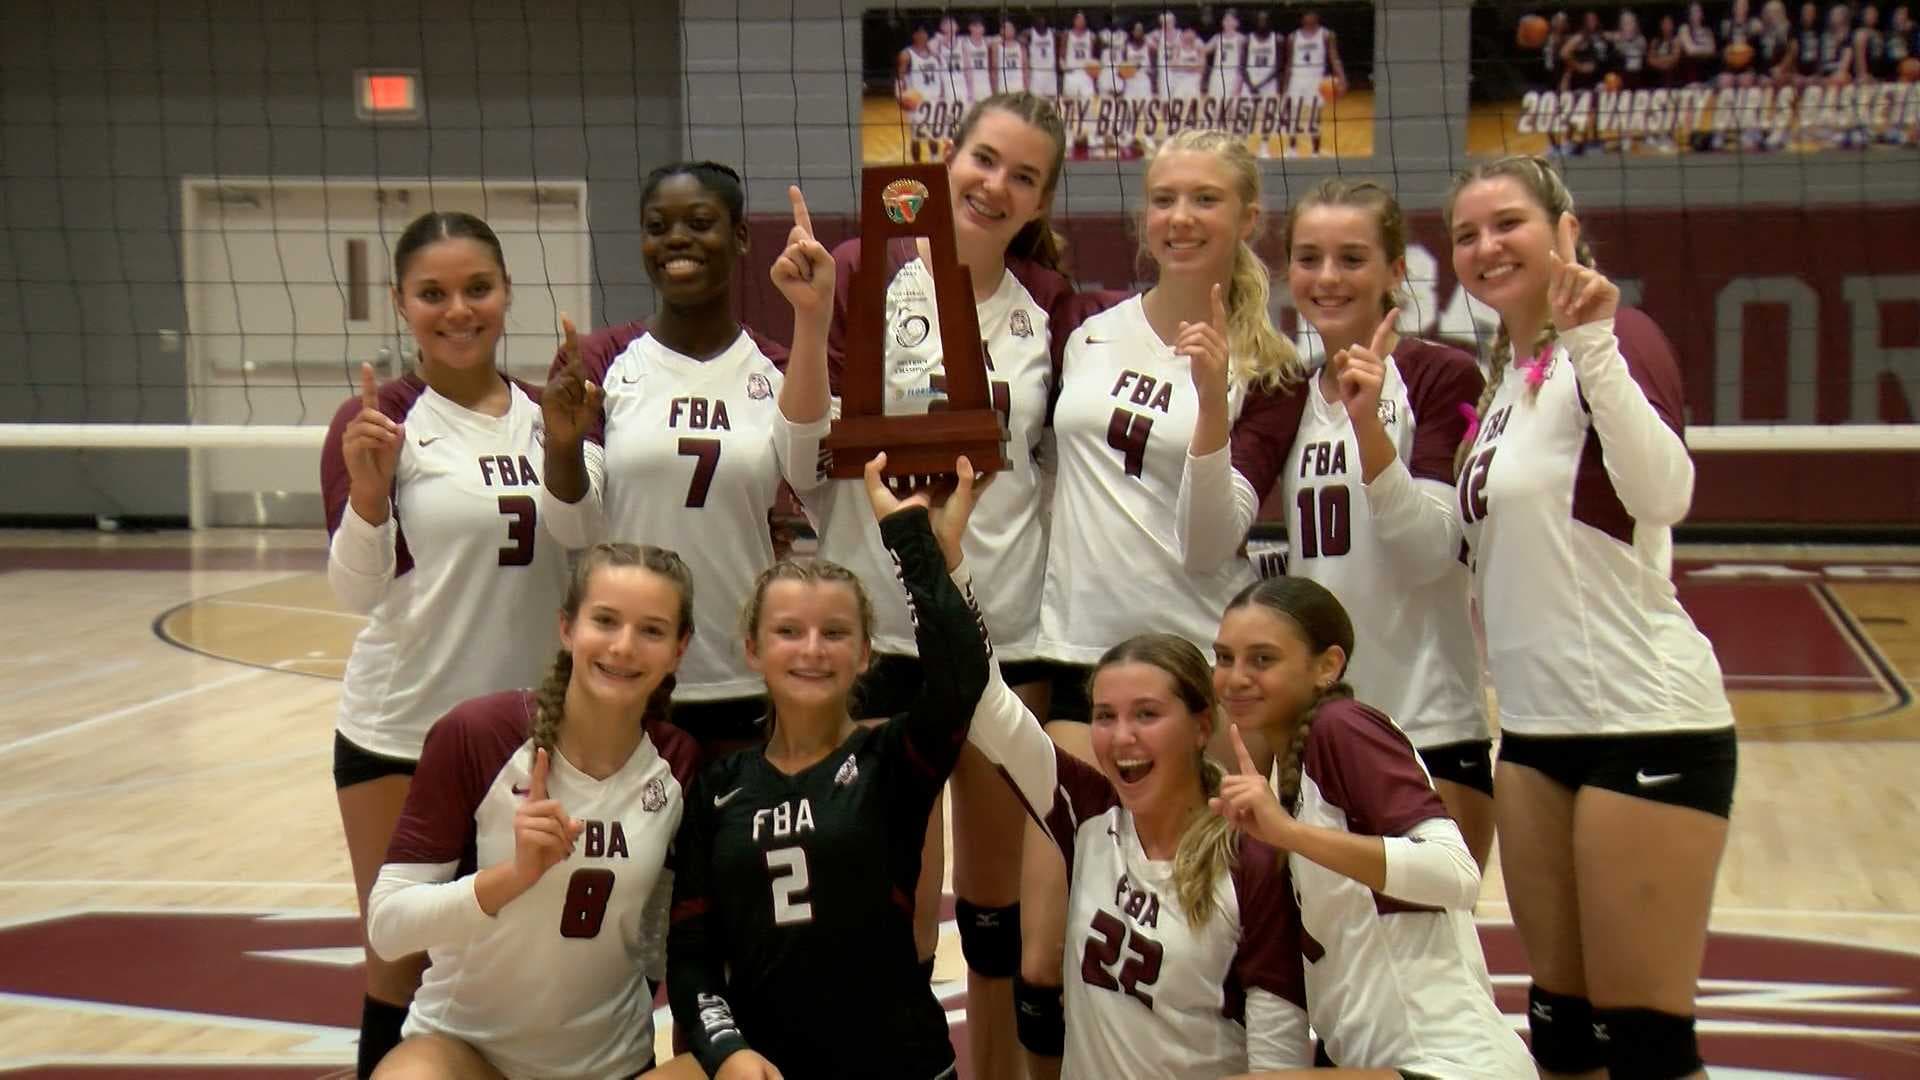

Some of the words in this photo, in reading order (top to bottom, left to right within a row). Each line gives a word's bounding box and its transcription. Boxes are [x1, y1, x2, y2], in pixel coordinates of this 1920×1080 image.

[1097, 100, 1162, 137] BOYS
[1166, 96, 1322, 136] BASKETBALL
[1518, 90, 1593, 133] 2024
[1597, 88, 1714, 131] VARSITY
[1714, 86, 1795, 130] GIRLS
[669, 397, 731, 430] FBA
[1111, 369, 1174, 414] FBA
[478, 455, 540, 486] FBA
[1106, 407, 1154, 480] 4
[1300, 440, 1347, 478] FBA
[678, 437, 721, 508] 7
[1459, 446, 1497, 525] 12
[498, 495, 537, 566] 3
[1297, 485, 1351, 559] 10
[580, 819, 629, 858] BA
[753, 801, 815, 841] FBA
[560, 868, 616, 938] 8
[766, 847, 812, 925] 2
[1116, 874, 1160, 929] FBA
[1081, 909, 1164, 1010] 22
